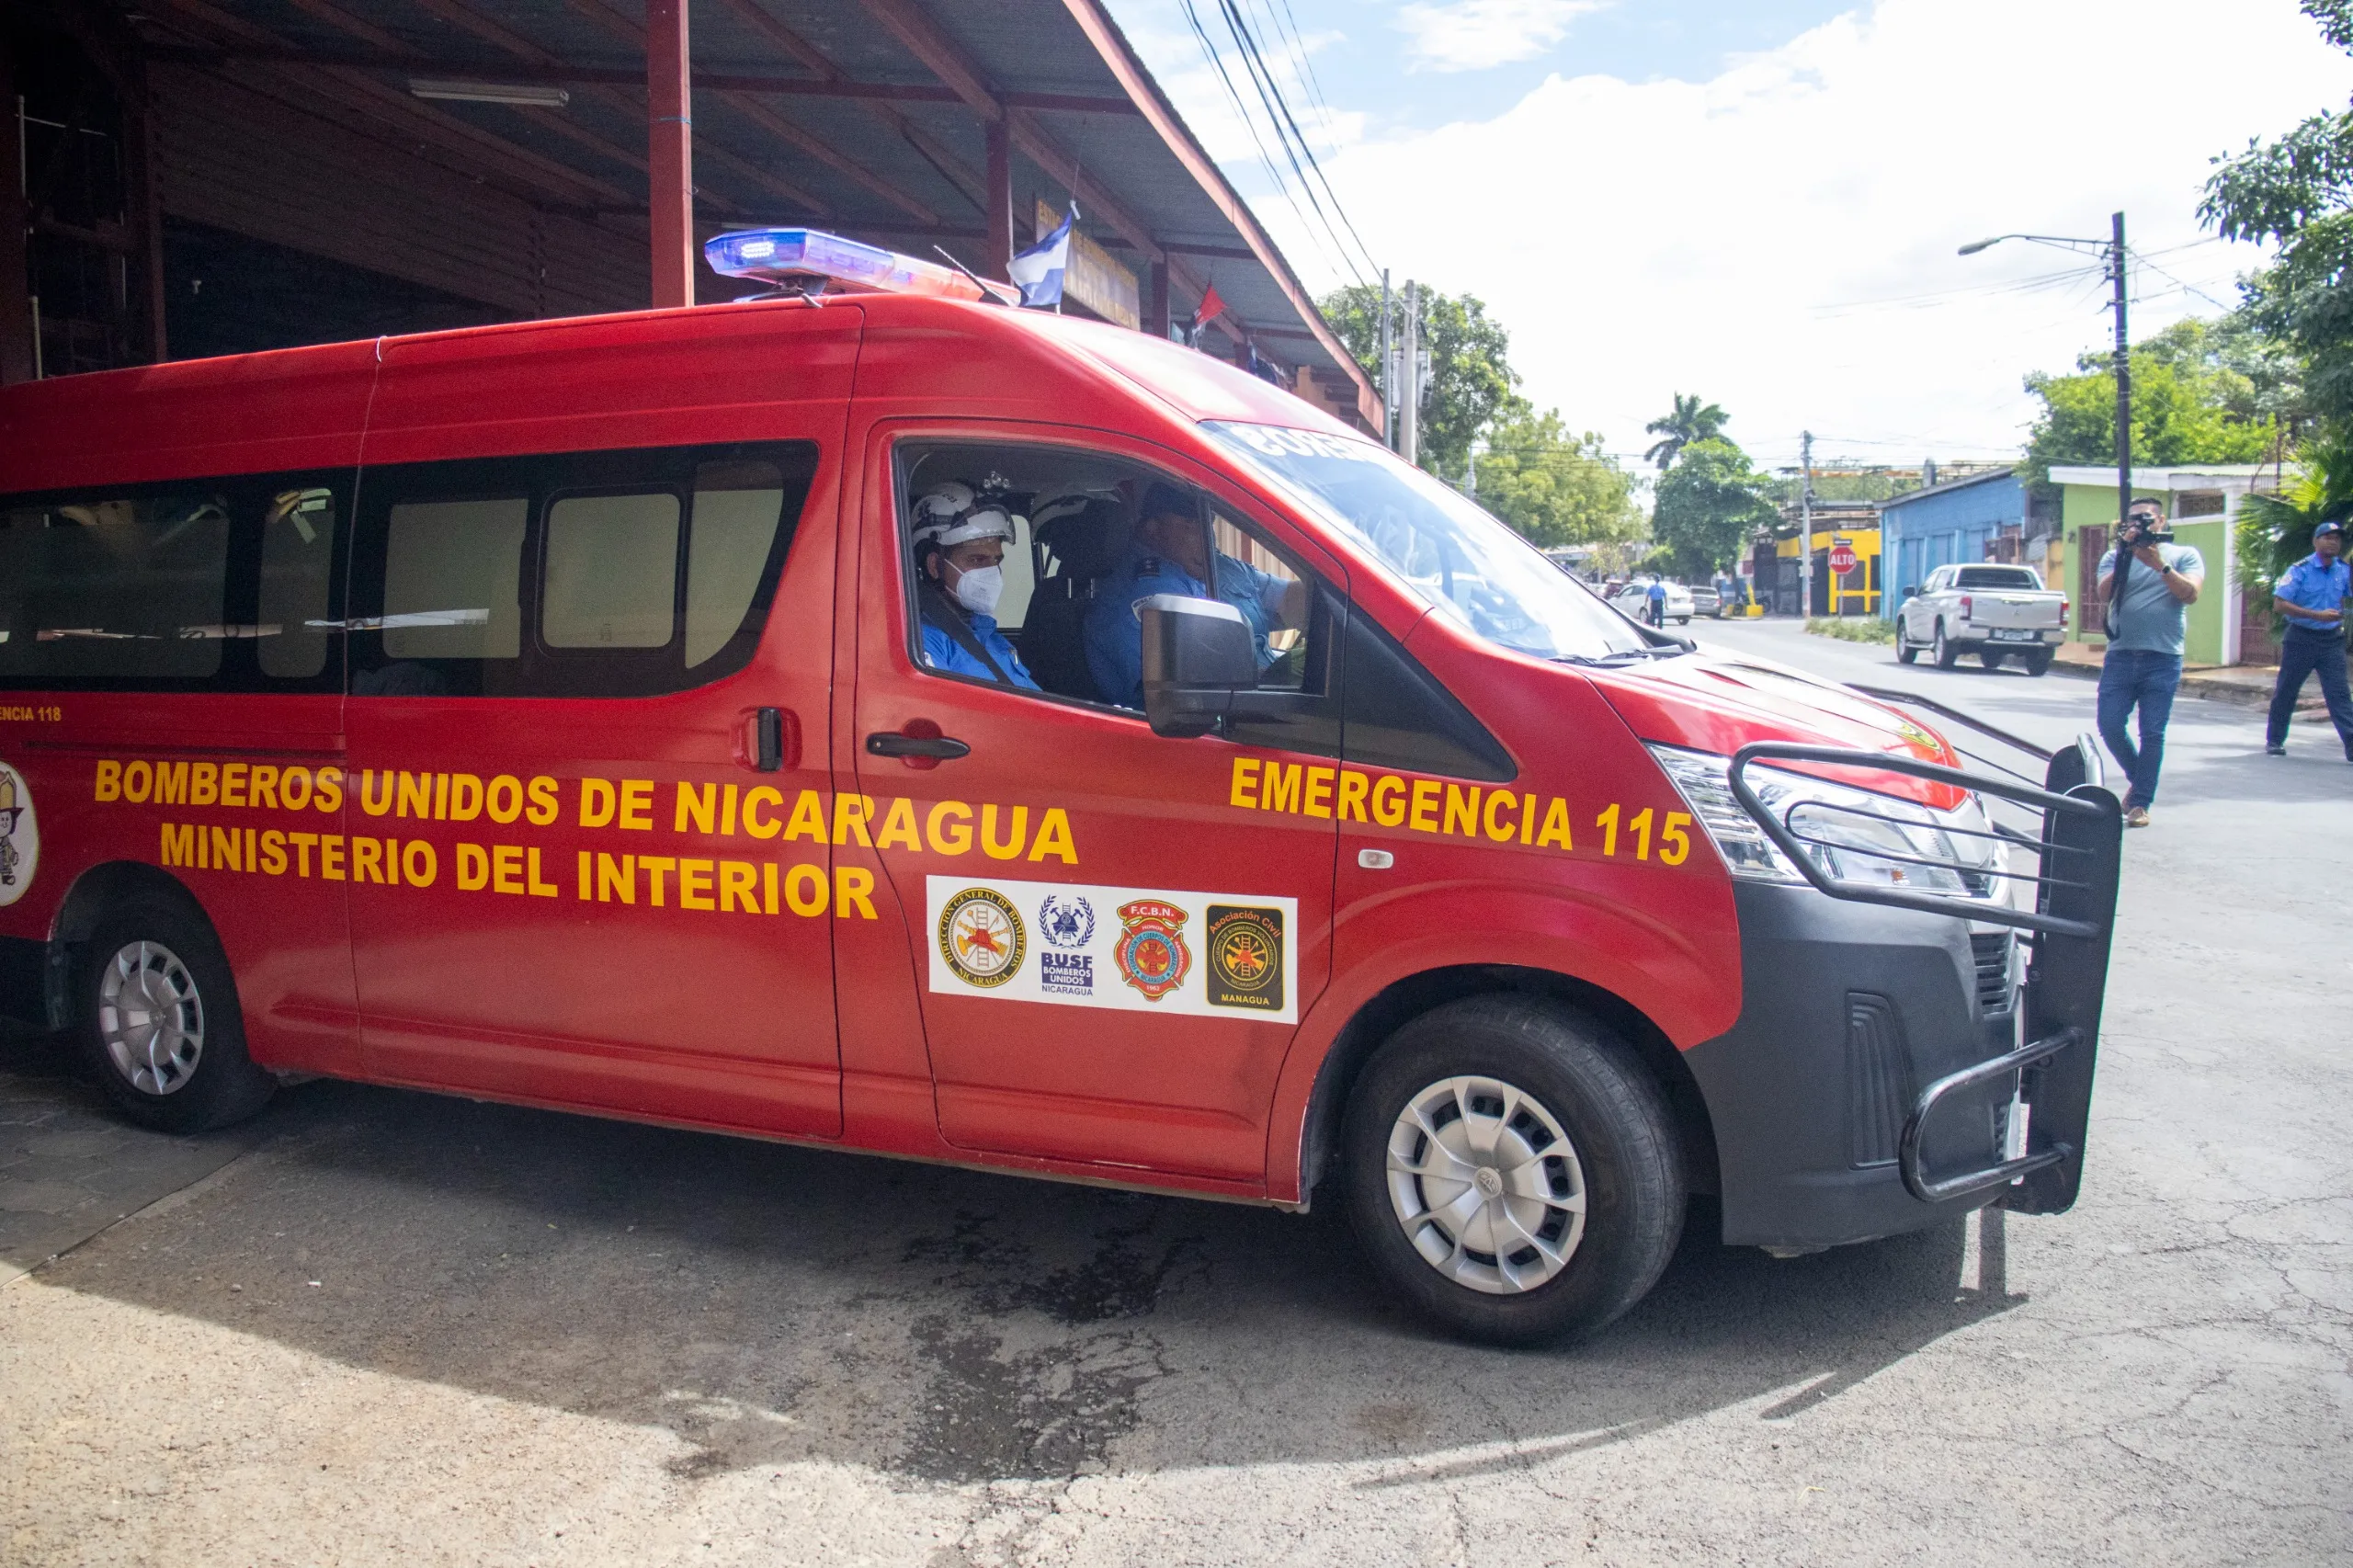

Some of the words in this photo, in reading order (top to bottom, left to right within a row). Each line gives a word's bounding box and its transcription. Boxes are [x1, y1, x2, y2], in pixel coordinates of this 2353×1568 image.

[1830, 554, 1855, 565] ALTO
[38, 707, 62, 722] 118
[96, 760, 343, 813] BOMBEROS
[362, 769, 559, 826] UNIDOS
[580, 778, 654, 831] DE
[676, 781, 1078, 865] NICARAGUA
[1231, 757, 1574, 851] EMERGENCIA
[1597, 803, 1692, 866] 115
[161, 823, 438, 888] MINISTERIO
[457, 843, 558, 898] DEL
[578, 851, 879, 920] INTERIOR
[1131, 905, 1175, 917] F.C.B.N.
[955, 892, 997, 907] GENERAL
[998, 897, 1011, 911] DE
[1008, 910, 1024, 968] BOMBEROS
[1209, 910, 1260, 935] Asociación
[1262, 917, 1281, 938] Civil
[1143, 933, 1165, 942] CUERPOS
[1169, 945, 1177, 972] BOMBEROS
[1228, 926, 1257, 934] BOMBEROS
[1256, 930, 1274, 965] VOLUNTARIOS
[1041, 952, 1093, 969] BUSF
[1121, 937, 1131, 973] DISCIPLINA
[959, 968, 1008, 985] NICARAGUA
[1043, 966, 1091, 978] BOMBEROS
[1050, 974, 1085, 985] UNIDOS
[1141, 974, 1165, 983] NICARAGUA
[1041, 984, 1093, 996] NICARAGUA
[1230, 978, 1261, 988] NICARAGUA
[1221, 994, 1270, 1006] MANAGUA
